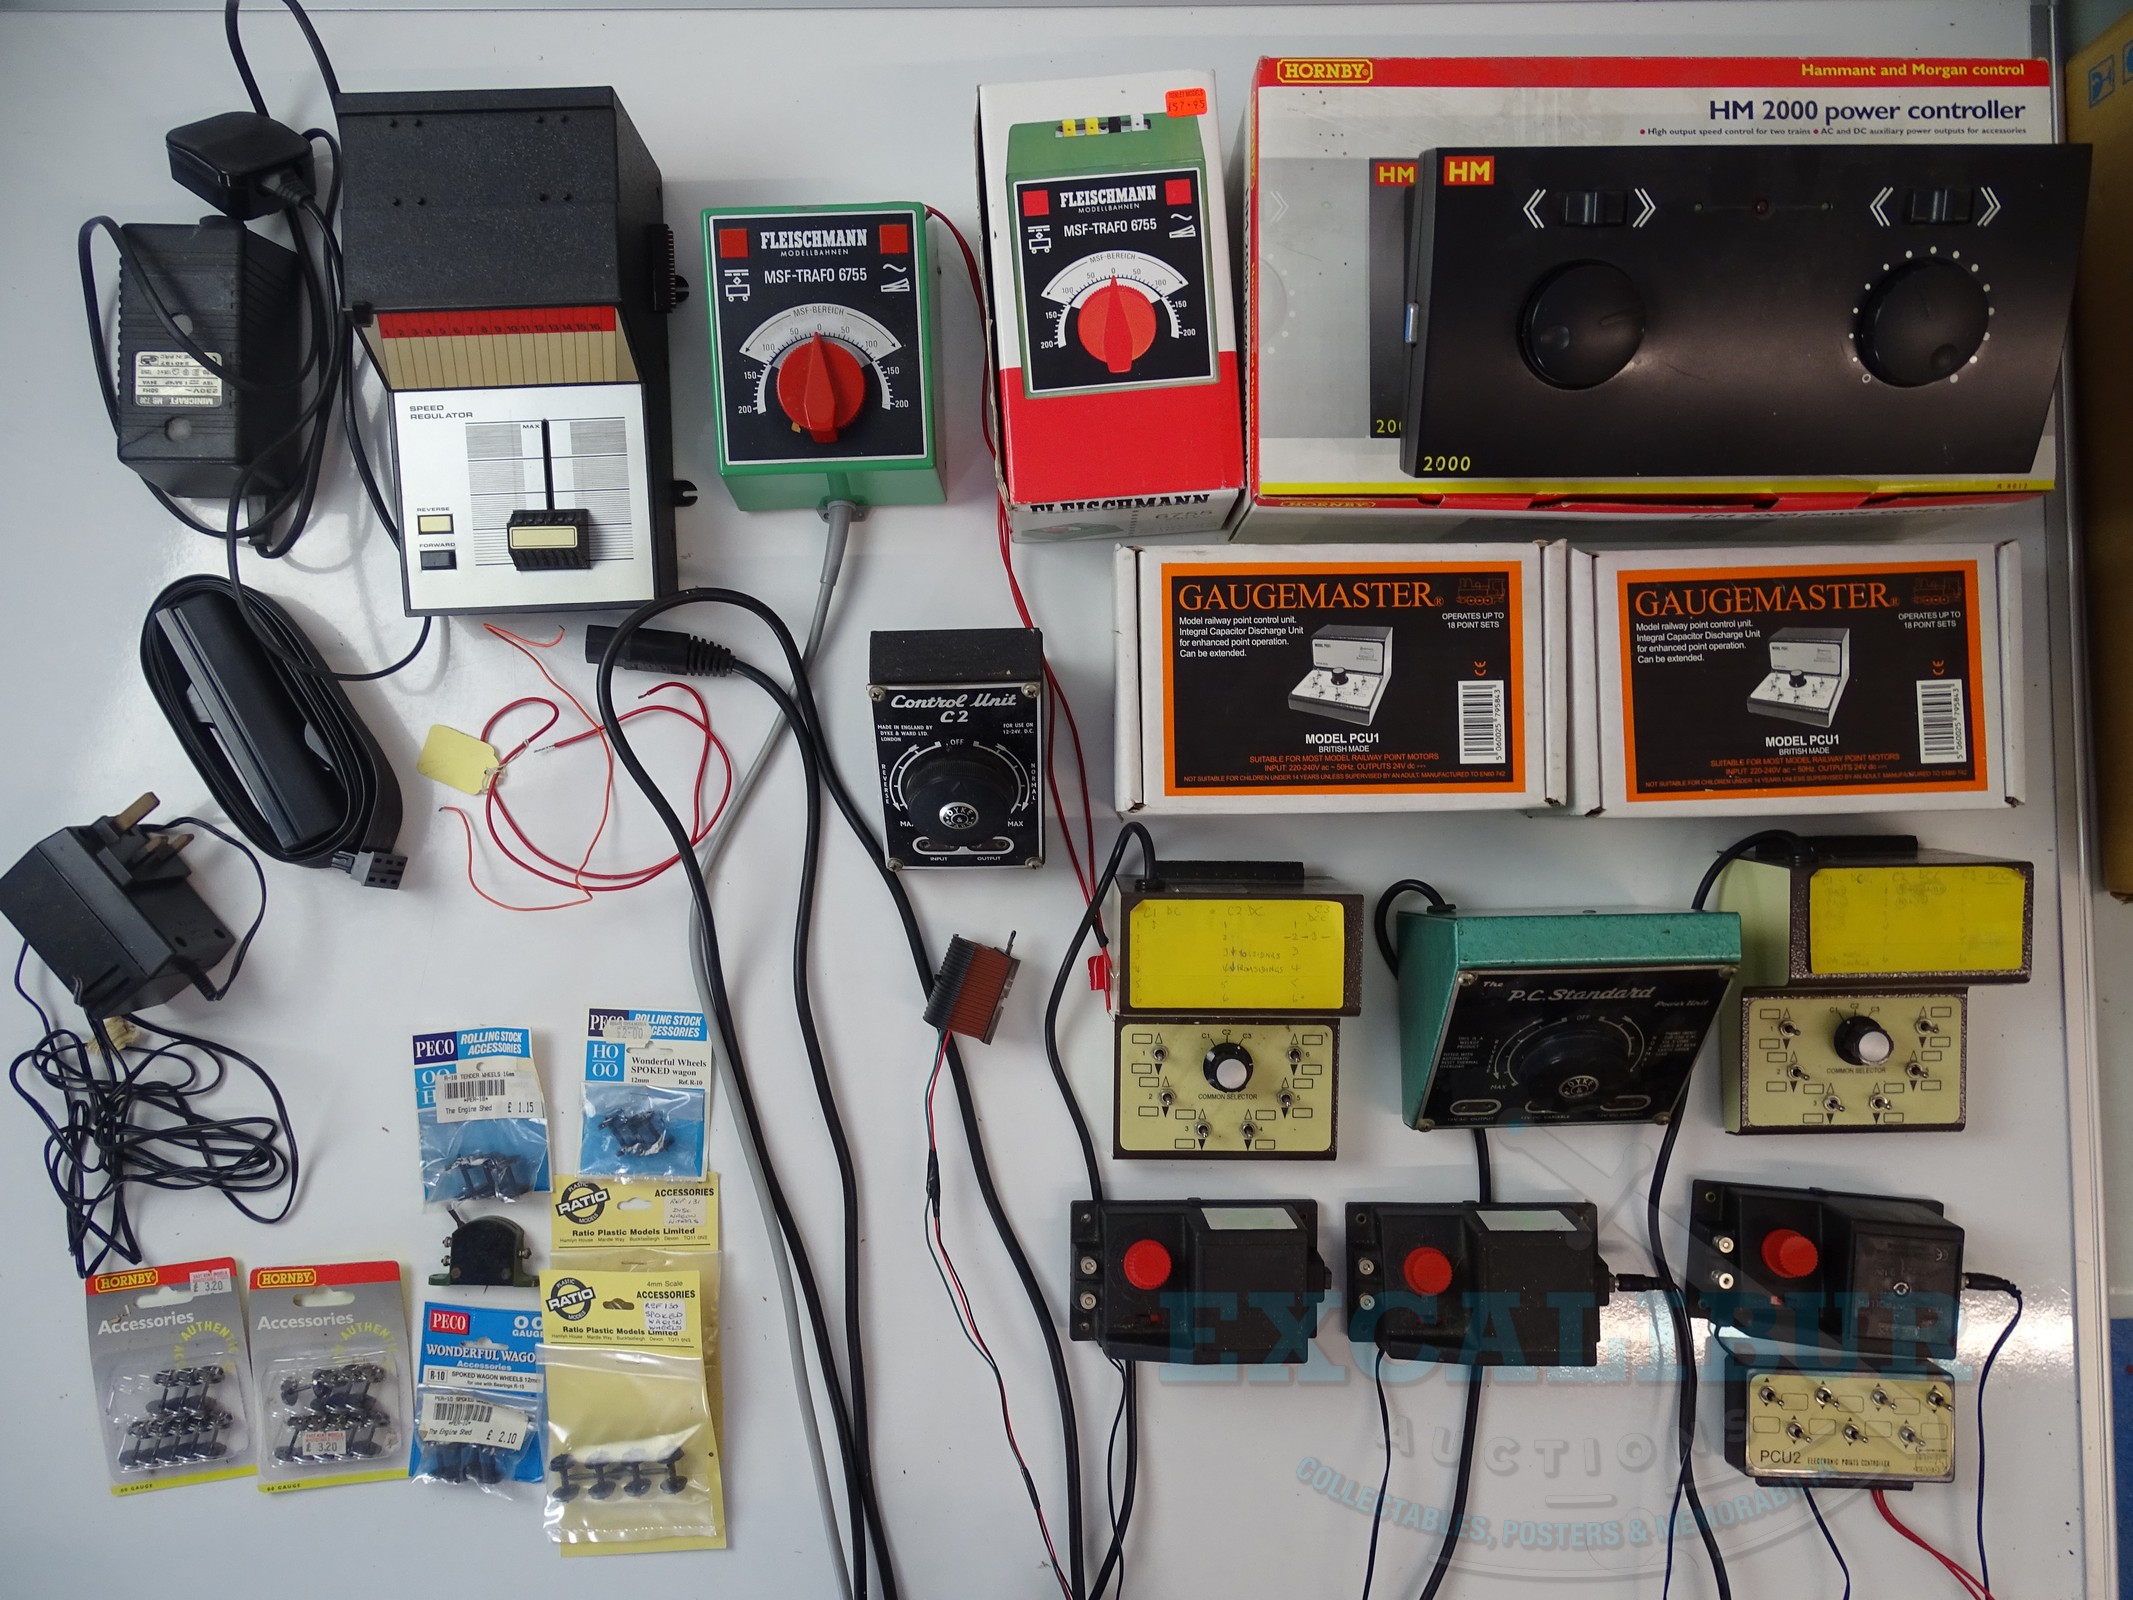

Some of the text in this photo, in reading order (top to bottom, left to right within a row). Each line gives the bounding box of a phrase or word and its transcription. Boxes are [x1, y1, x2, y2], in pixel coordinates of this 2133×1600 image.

[1284, 64, 1363, 79] HORNBY
[1802, 64, 2024, 78] Hammant and Morgan control
[1710, 100, 2025, 125] HM 2000 power controller
[1870, 128, 1903, 136] auxiliary
[1379, 166, 1415, 182] HM
[1449, 162, 1490, 181] HM
[1060, 185, 1156, 208] FLEISCHMANN
[1078, 203, 1140, 213] MODELLBAHNEN
[1064, 219, 1156, 237] MSF-TRAFO 6755
[761, 229, 867, 249] FLEISCHMANN
[781, 249, 848, 257] MODELLBAHNEN
[764, 268, 867, 284] MSF-TRAFO 6755
[793, 306, 844, 317] MSF-BEREICH
[744, 371, 757, 379] 150
[887, 367, 899, 375] 150
[170, 397, 214, 405] MINICRAFT
[895, 400, 908, 408] 200
[738, 405, 752, 413] 200
[410, 412, 473, 420] REGULATOR
[1423, 456, 1471, 472] 2000
[1178, 581, 1435, 611] GAUGEMASTER
[1635, 582, 1891, 617] GAUGEMASTER
[1179, 617, 1203, 625] Model
[1205, 617, 1231, 626] railway
[1233, 616, 1252, 625] point
[1254, 616, 1279, 624] control
[1180, 626, 1303, 637] Integral Capacitor Discharge Unit
[1192, 638, 1229, 646] enhanced
[1231, 638, 1250, 647] point
[1252, 638, 1289, 647] operation.
[1210, 649, 1247, 657] extended.
[891, 693, 1016, 708] Control Unit
[1305, 733, 1379, 744] MODEL PCU1
[1765, 735, 1839, 747] MODEL PCU1
[1318, 745, 1348, 753] BRITISH
[1250, 755, 1284, 763] SUITABLE
[1324, 754, 1351, 762] MODEL
[1549, 987, 1656, 1001] Standard
[673, 1015, 702, 1026] STOCK
[461, 1032, 522, 1044] ROLLING STOCK
[416, 1039, 454, 1057] PECO
[468, 1043, 521, 1055] ACCESSORIES
[593, 1044, 619, 1059] HO
[632, 1057, 706, 1067] Wonderful Wheels
[592, 1063, 618, 1077] OO
[631, 1066, 696, 1077] SPOKED wagon
[458, 1106, 476, 1114] Engine
[508, 1102, 533, 1113] £ 1.15
[655, 1188, 714, 1197] ACCESSORIES
[558, 1190, 608, 1215] RATIO
[101, 1272, 152, 1289] HORNBY
[262, 1273, 311, 1285] HORNBY
[205, 1280, 223, 1291] 3.20
[548, 1289, 594, 1311] RATIO
[637, 1290, 695, 1299] ACCESSORIES
[98, 1312, 194, 1335] Accessories
[257, 1313, 354, 1330] Accessories
[432, 1313, 466, 1330] PECO
[427, 1344, 499, 1361] WONDERFUL
[457, 1360, 512, 1371] Accessories
[430, 1371, 445, 1380] R-10
[452, 1371, 475, 1379] SPOKED
[486, 1430, 517, 1444] £ 2.10
[1760, 1450, 1801, 1464] PCU2
[1808, 1457, 1890, 1467] ELECTRONIC POINTS CONTROLLER
